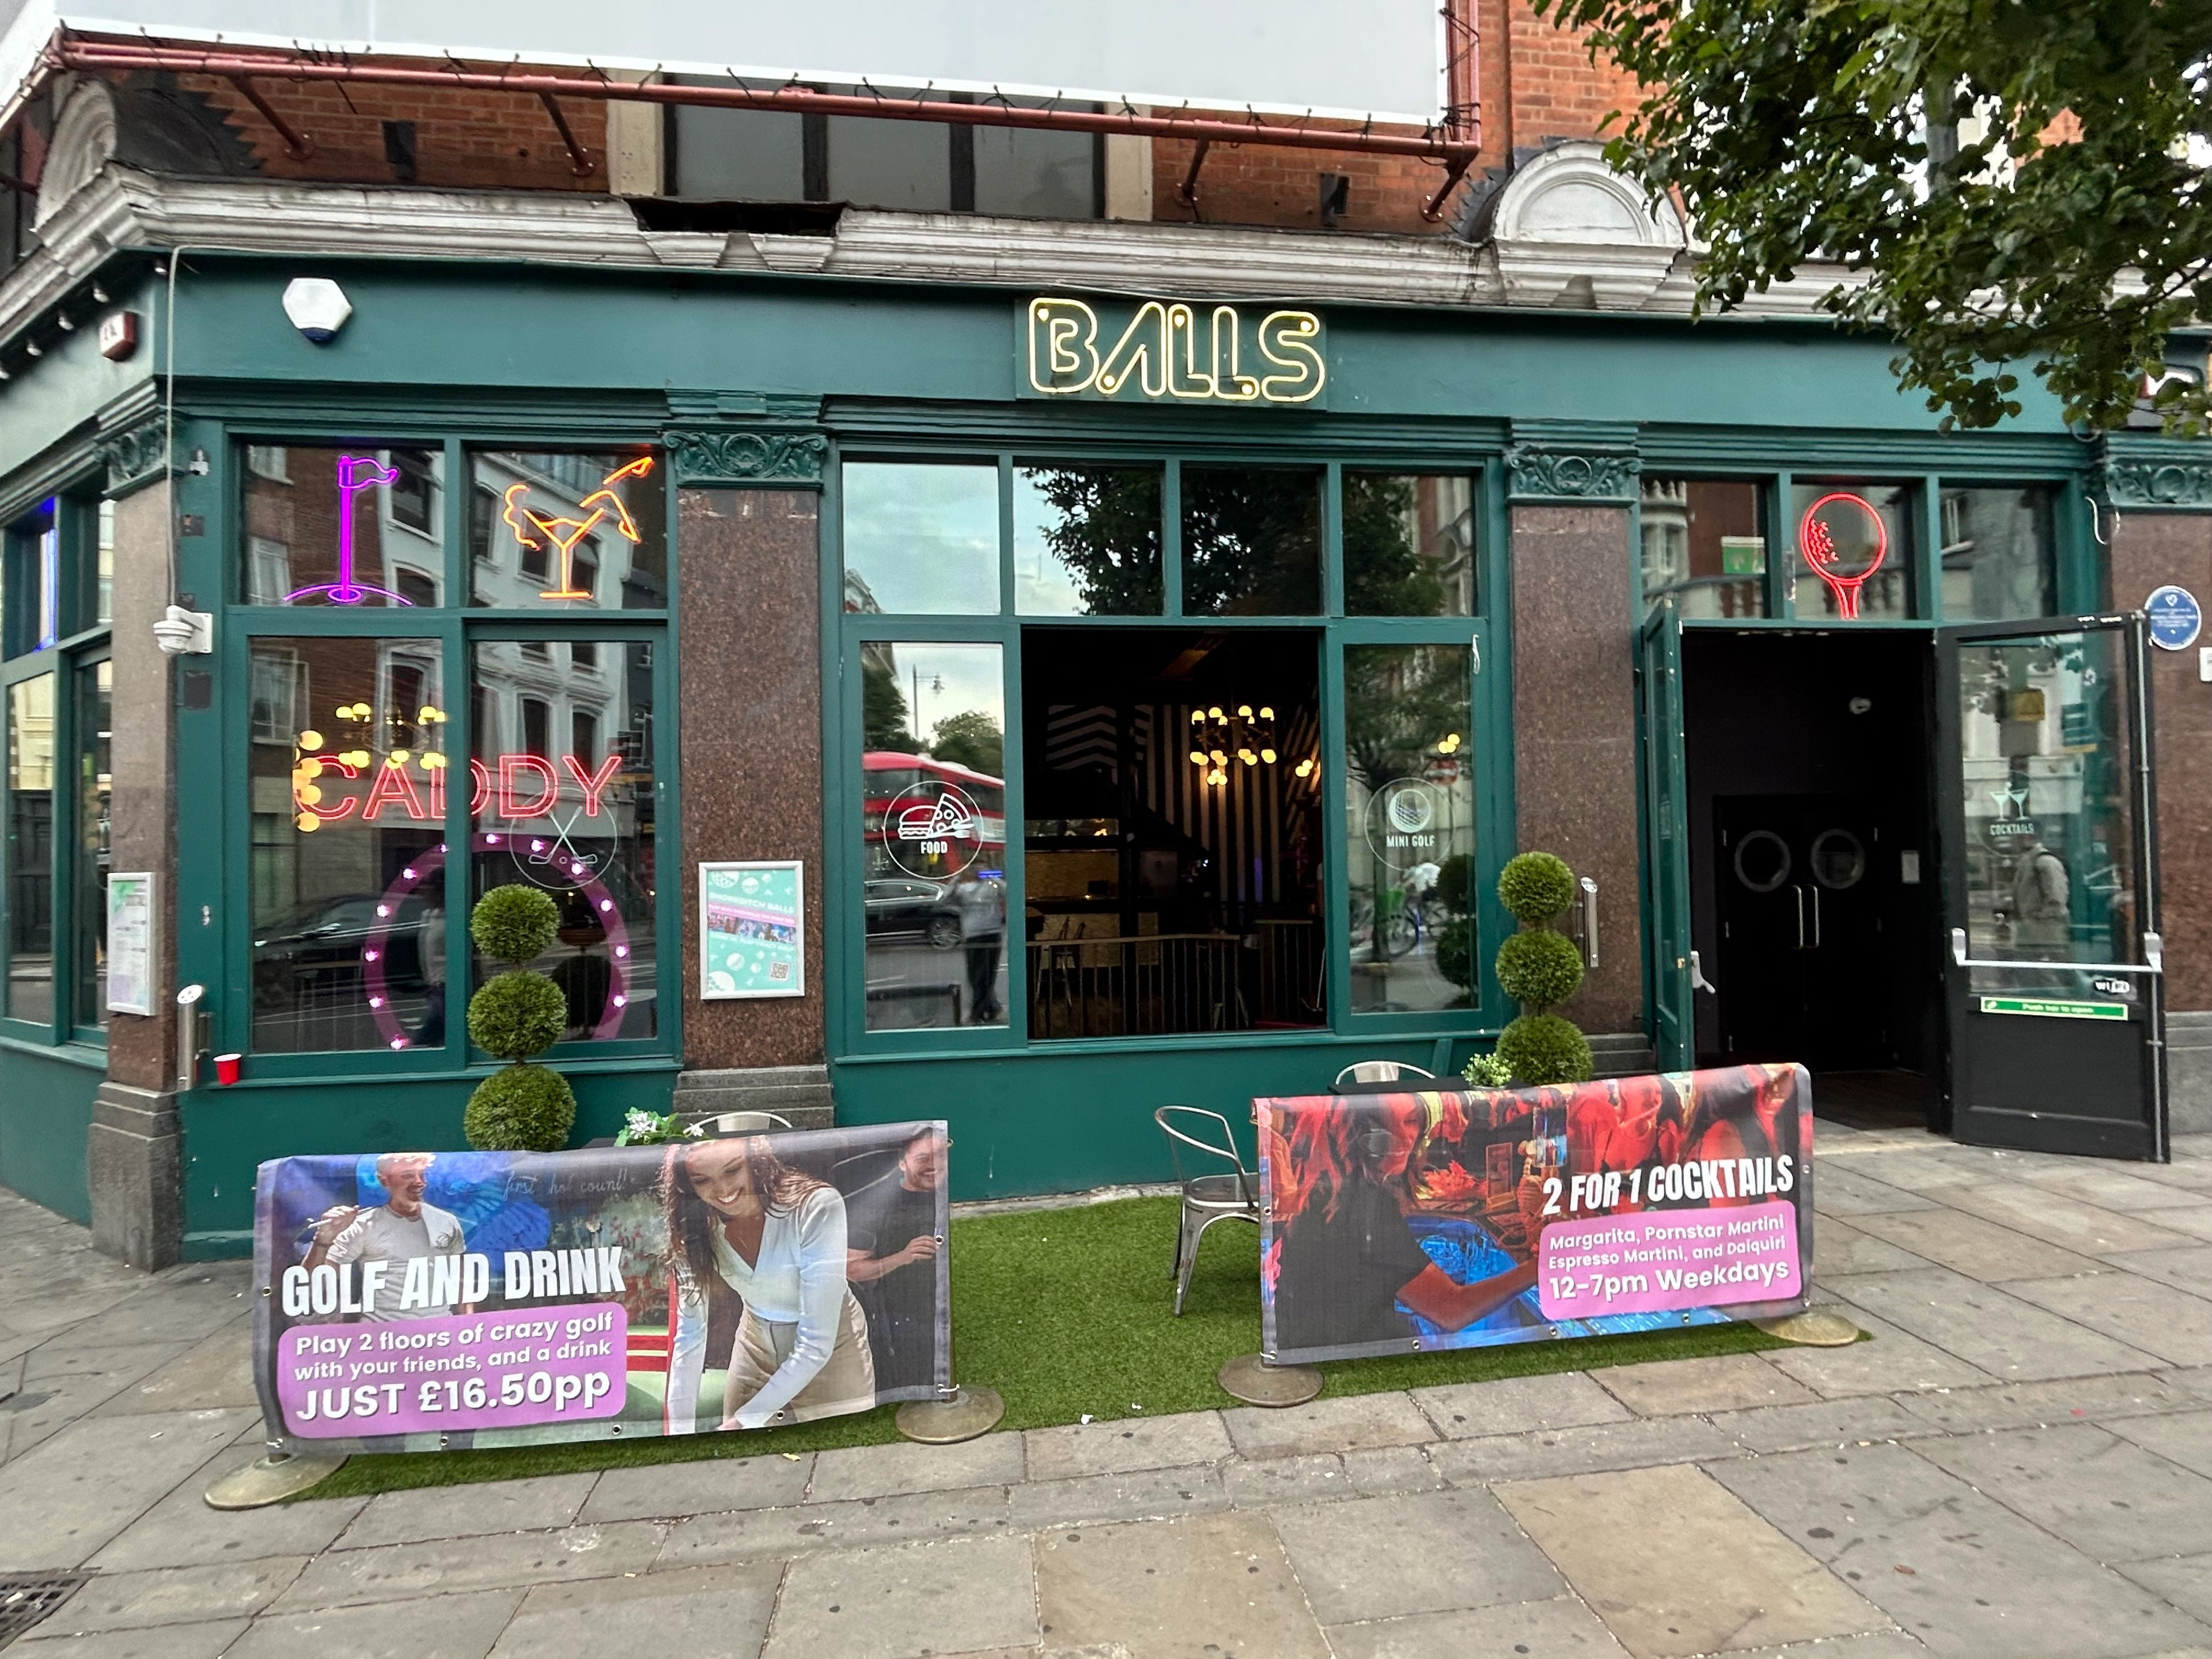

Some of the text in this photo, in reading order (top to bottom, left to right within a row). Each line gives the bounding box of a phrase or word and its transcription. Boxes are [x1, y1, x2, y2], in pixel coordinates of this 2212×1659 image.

[1029, 297, 1325, 402] BALLS
[294, 754, 622, 820] CADDY
[921, 841, 948, 854] FOOD
[1387, 835, 1435, 847] MINI GOLF
[1990, 823, 2035, 835] COCKTAILS
[1543, 1154, 1794, 1215] 2 FOR 1 COCKTAILS
[1548, 1234, 1786, 1272] Espresso Martini, and Daiquiri
[1549, 1213, 1785, 1252] Margarita, Pornstar Martini
[282, 1246, 626, 1317] GOLF AND DRINK
[1656, 1260, 1789, 1292] Weekdays
[296, 1312, 613, 1358] Play 2 floors of crazy golf
[295, 1339, 612, 1381] with your friends, and a drink
[296, 1370, 611, 1421] JUST £16.50pp
